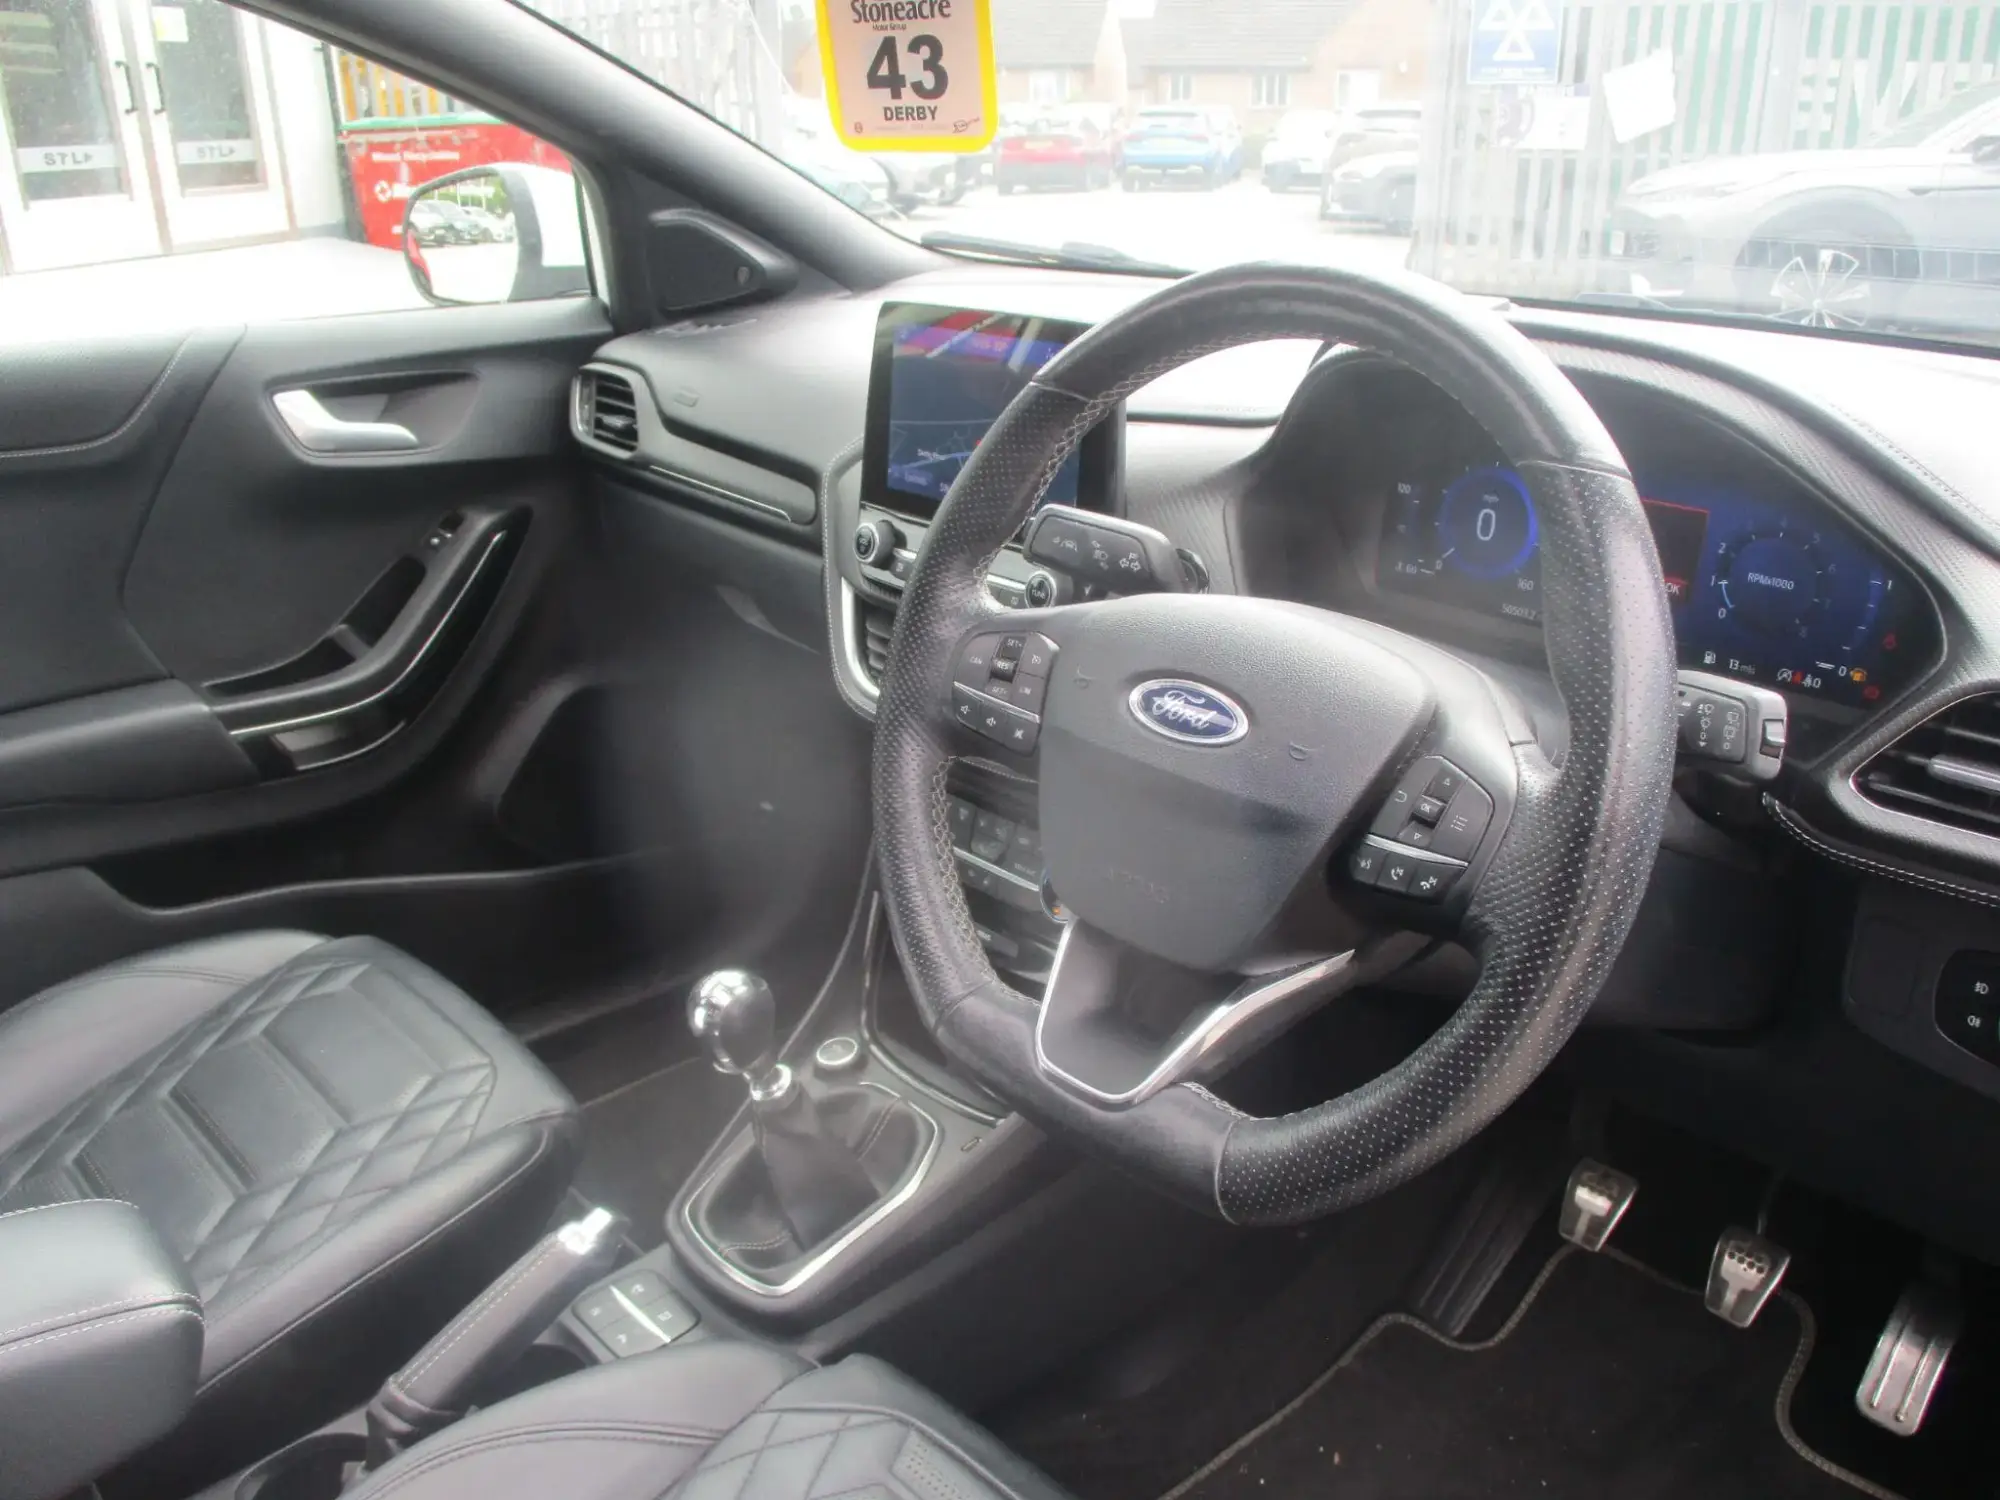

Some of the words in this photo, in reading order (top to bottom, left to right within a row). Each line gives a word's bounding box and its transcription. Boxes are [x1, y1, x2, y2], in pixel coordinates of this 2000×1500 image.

[850, 0, 951, 23] Stoneacre
[866, 34, 949, 100] 43
[883, 105, 938, 121] DERBY
[1477, 508, 1496, 541] 0
[1717, 542, 1726, 554] 2
[1517, 577, 1534, 591] 160
[1665, 582, 1680, 595] OK
[1718, 607, 1727, 619] 0
[1729, 659, 1740, 670] 13
[1838, 665, 1847, 677] 0
[1152, 690, 1218, 730] Ford
[1420, 803, 1432, 814] OK
